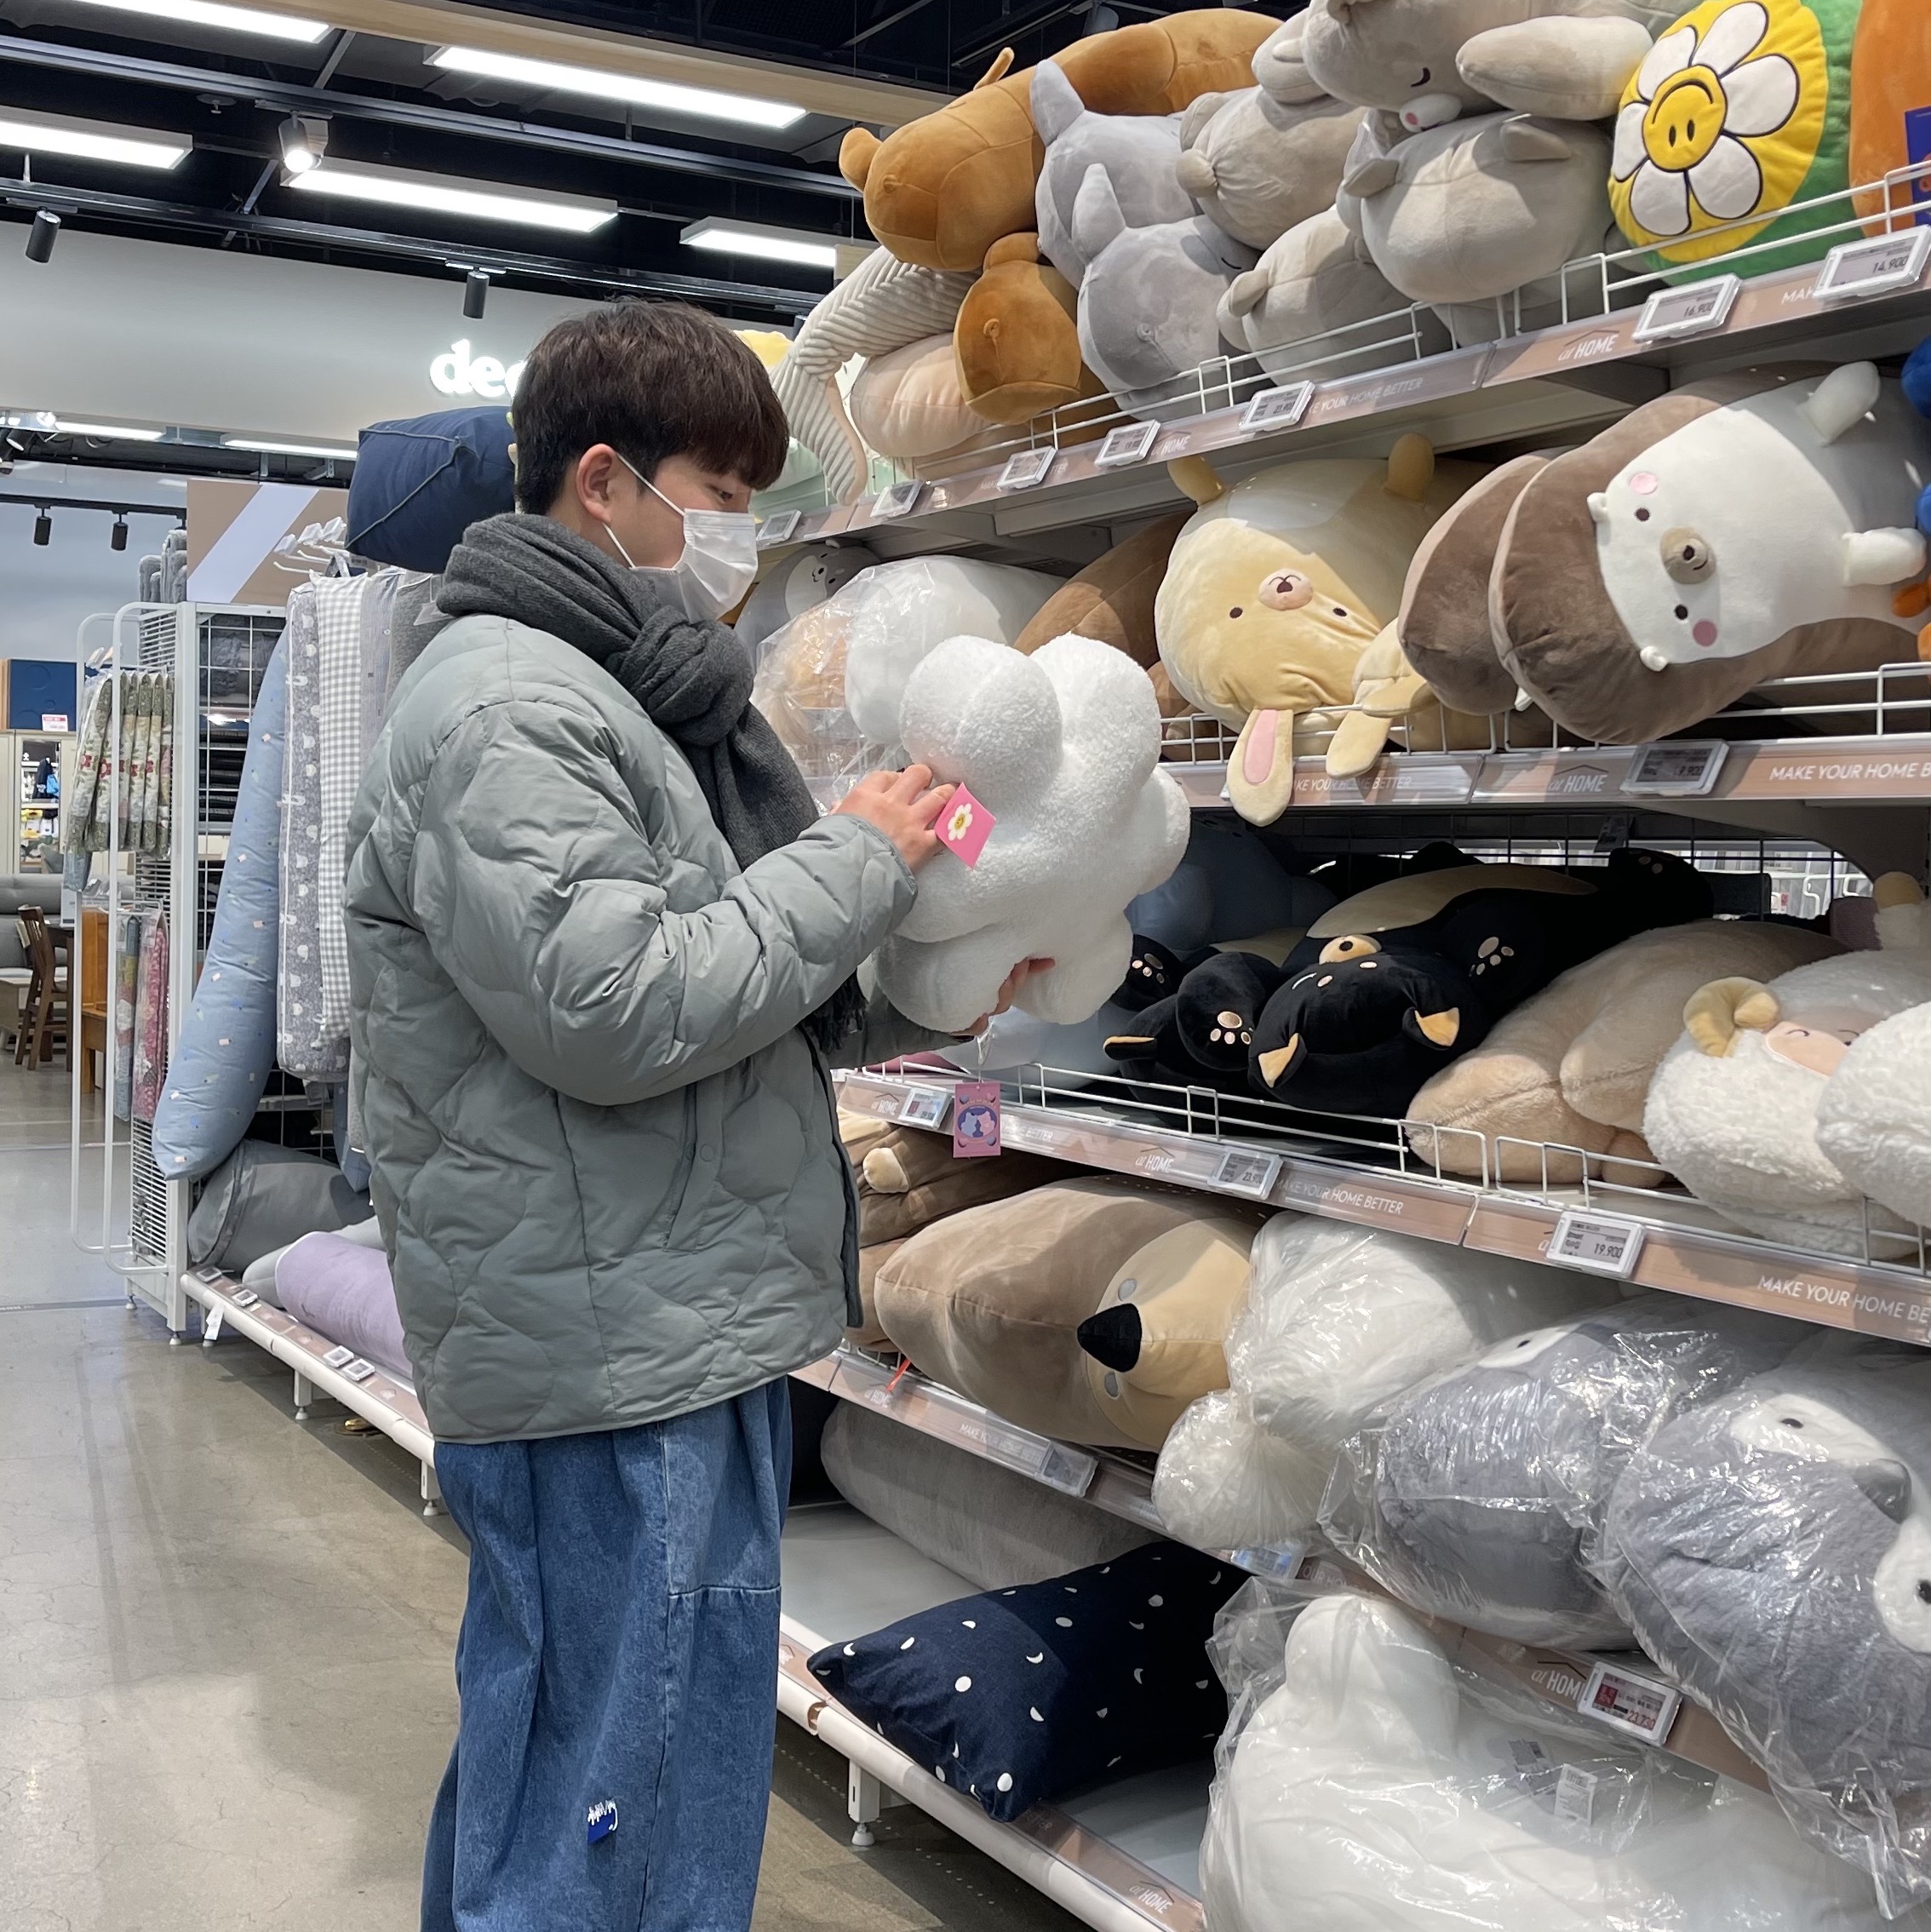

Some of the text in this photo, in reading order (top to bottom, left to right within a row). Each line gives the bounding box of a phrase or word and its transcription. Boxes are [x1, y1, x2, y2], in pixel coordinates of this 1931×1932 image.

[1573, 335, 1619, 359] HOME
[1321, 396, 1349, 411] YOUR
[1349, 387, 1384, 403] HOME
[1383, 377, 1424, 397] BETTER
[1161, 435, 1190, 455] HOME
[1769, 765, 1816, 780] MAKE
[1819, 764, 1862, 779] YOUR
[1865, 763, 1919, 778] HOME
[1295, 779, 1310, 791] KE
[1372, 776, 1412, 790] BETTER
[1563, 774, 1607, 792] HOME
[878, 1099, 899, 1115] HOME
[1026, 1127, 1054, 1141] BETTER
[1145, 1155, 1175, 1172] HOME
[1277, 1179, 1403, 1214] MAKE YOUR HOME BETTER
[1756, 1275, 1804, 1298] MAKE
[1806, 1285, 1850, 1307] YOUR
[1852, 1293, 1906, 1318] HOME
[960, 1424, 980, 1440] MAKE
[1532, 1670, 1549, 1684] at
[1138, 1889, 1172, 1914] HOME
